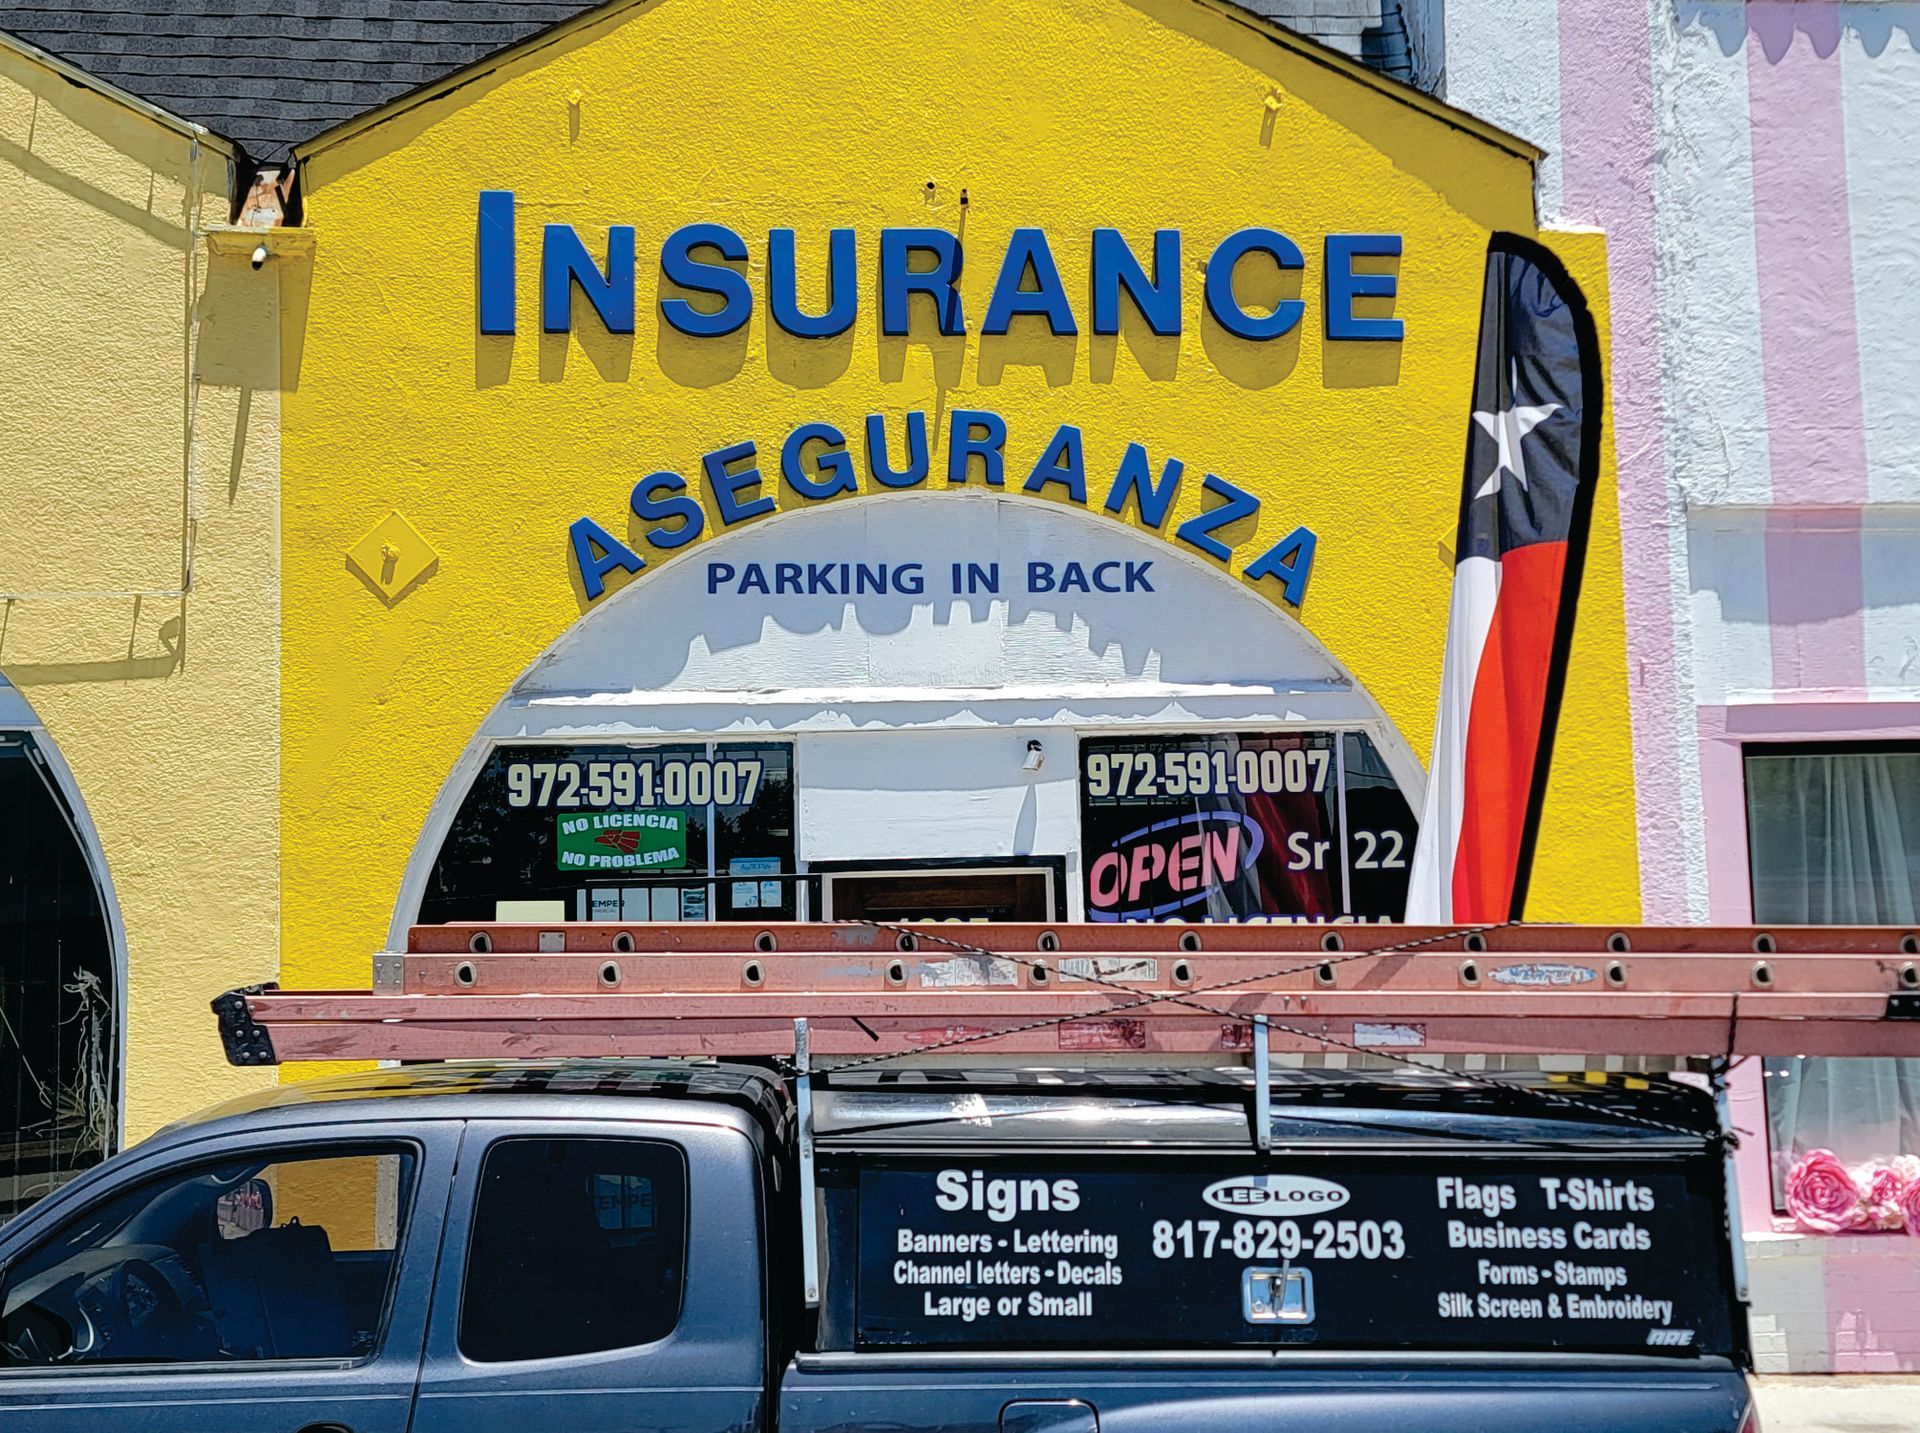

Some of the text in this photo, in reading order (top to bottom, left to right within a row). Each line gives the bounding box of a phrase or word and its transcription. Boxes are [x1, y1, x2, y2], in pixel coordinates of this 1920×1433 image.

[480, 190, 1404, 340] INSURANCE
[570, 410, 1317, 607] ASEGURANZA
[707, 562, 1155, 594] PARKING IN BACK
[507, 761, 762, 807] 972-591-0007
[1086, 750, 1331, 797] 972-591-0007
[562, 813, 679, 835] NO LICENCIA
[561, 846, 680, 869] NO PROBLEMA
[1089, 825, 1241, 908] OPEN
[1287, 830, 1406, 871] Sr 22
[935, 1169, 1080, 1222] Signs
[1217, 1189, 1344, 1203] LEE LOGO
[1437, 1177, 1655, 1218] Flags T-Shirts
[898, 1229, 993, 1253] Banners
[1013, 1229, 1118, 1259] Lettering
[1152, 1220, 1406, 1259] 817-829-2503
[1447, 1220, 1651, 1250] Business Cards
[893, 1260, 971, 1285] Channel
[977, 1260, 1041, 1285] letters
[1057, 1260, 1123, 1286] Decals
[1478, 1259, 1539, 1285] Forms
[1554, 1260, 1628, 1292] Stamps
[924, 1291, 1093, 1321] Large or Small
[1438, 1292, 1673, 1326] Silk Screen & Embroidery
